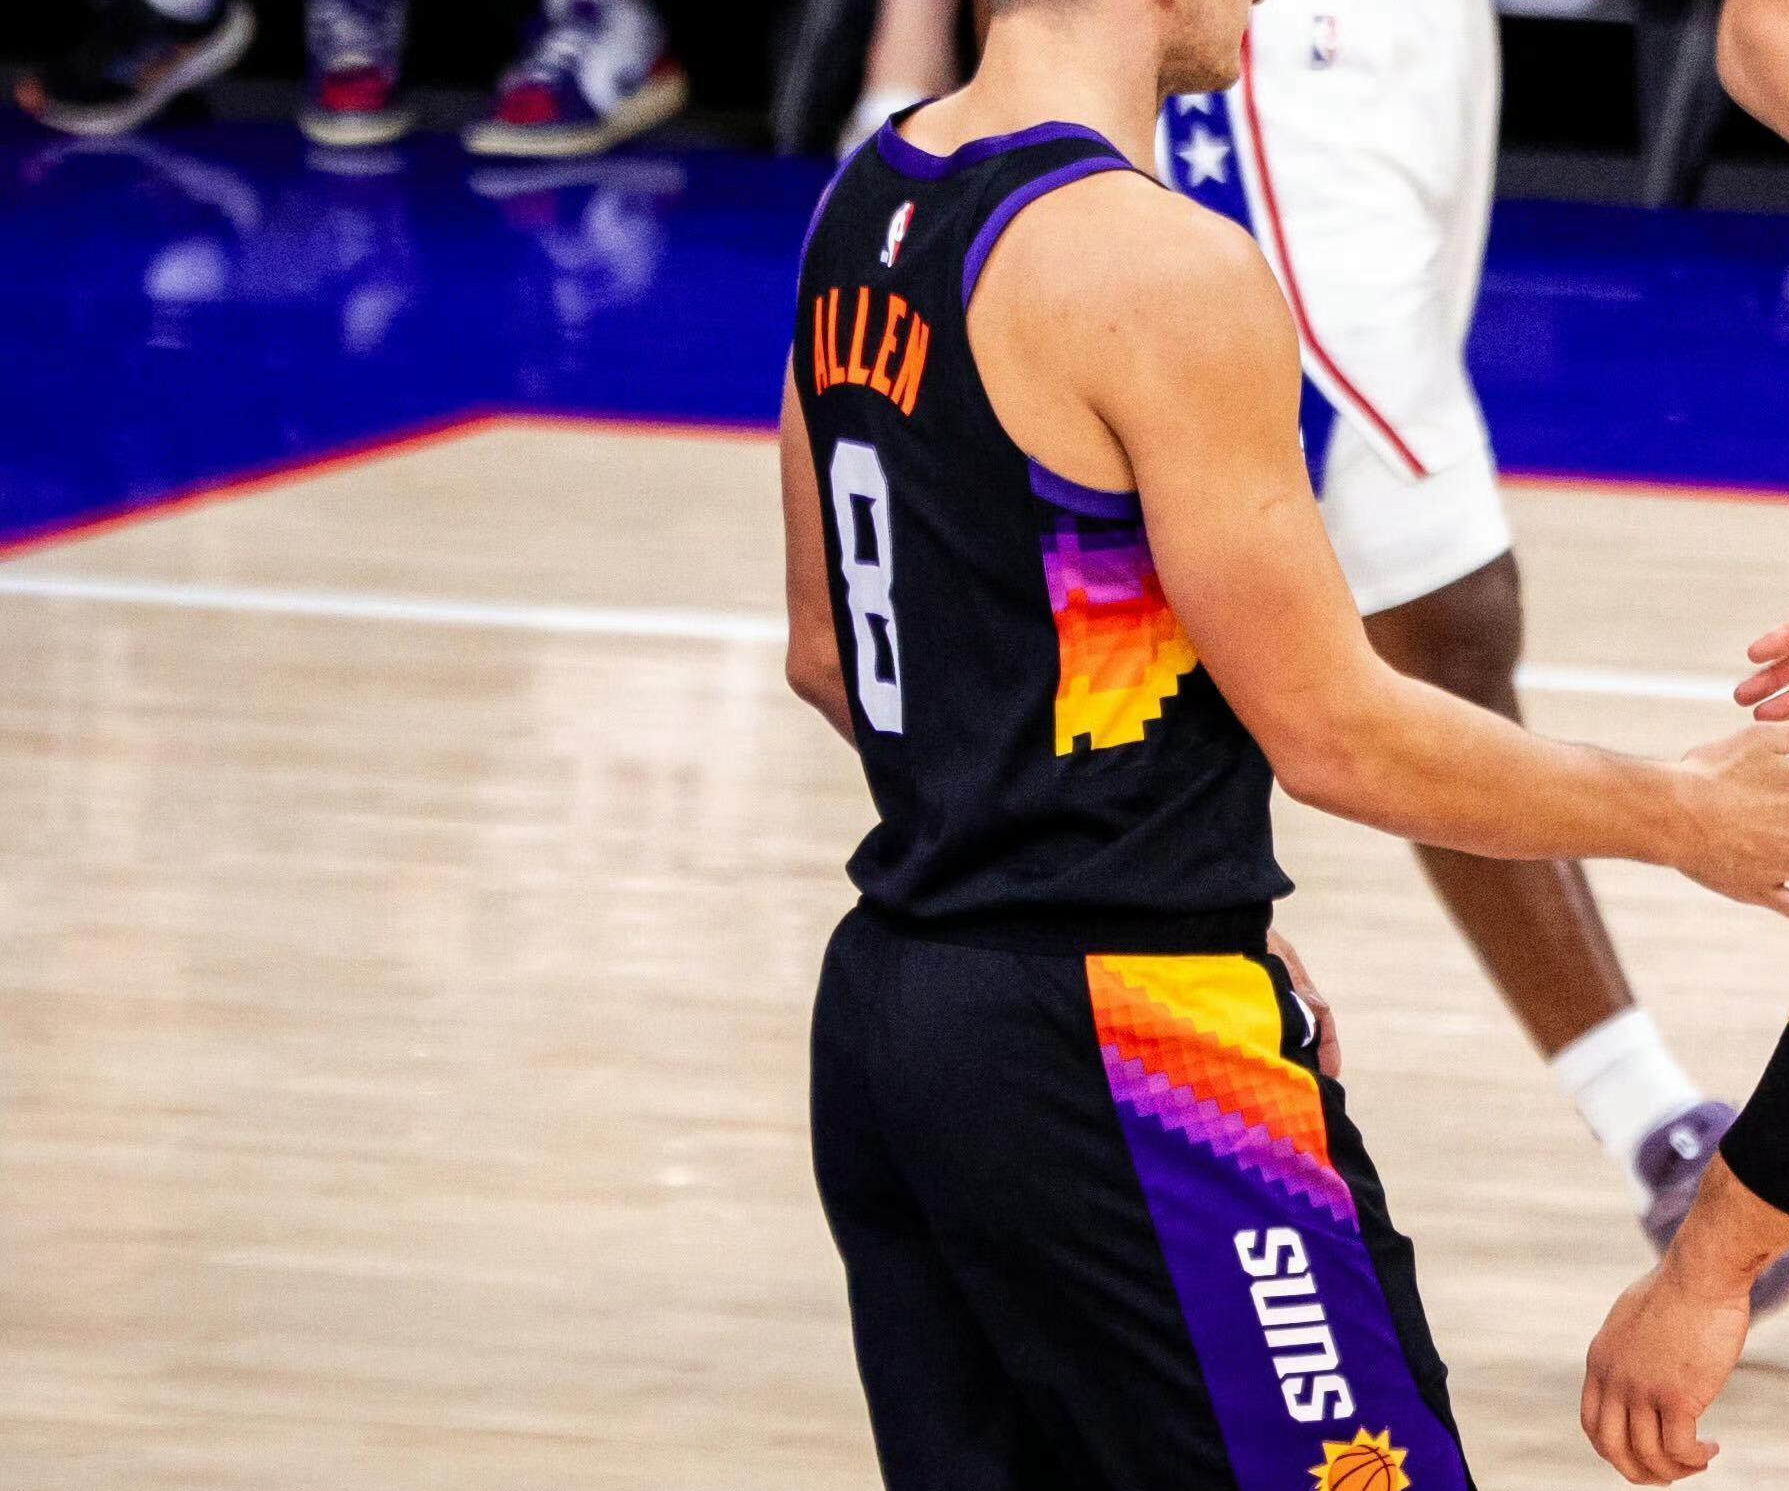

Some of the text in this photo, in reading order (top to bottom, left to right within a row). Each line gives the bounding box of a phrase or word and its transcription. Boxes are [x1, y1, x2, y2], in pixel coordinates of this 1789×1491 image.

[813, 286, 930, 417] ALLEN
[829, 439, 903, 735] 8
[1233, 1226, 1356, 1422] SUNS
